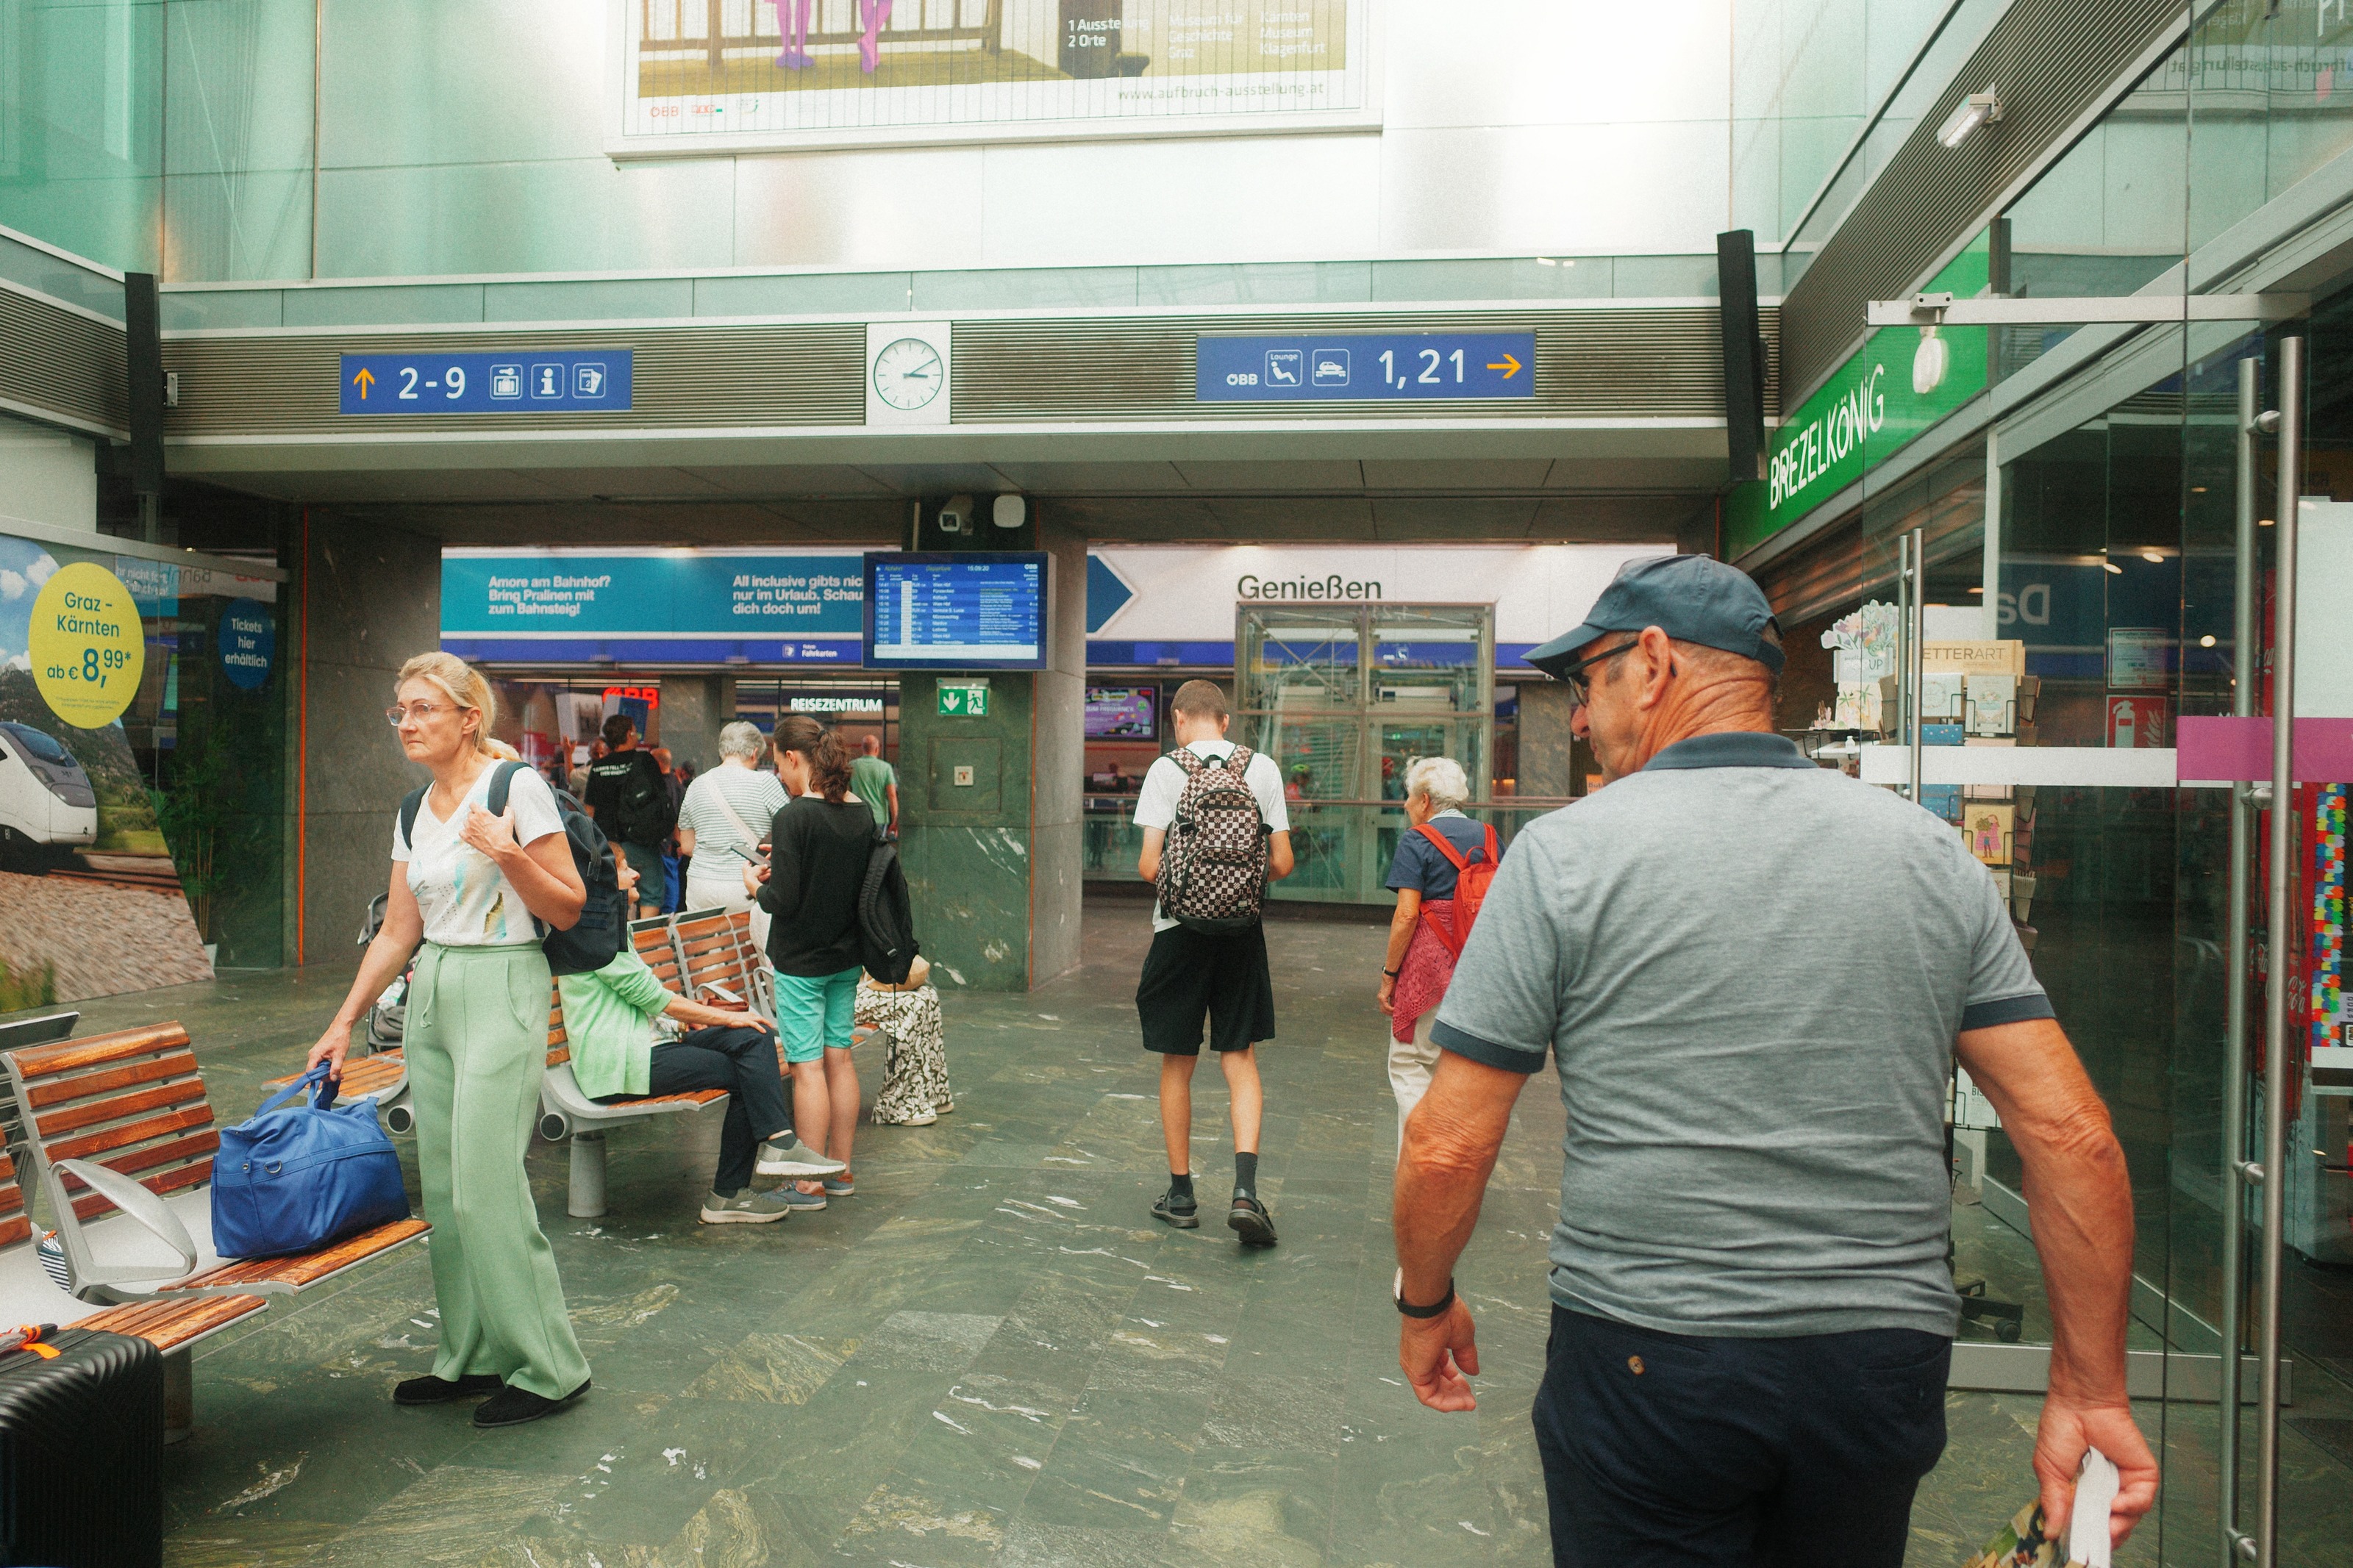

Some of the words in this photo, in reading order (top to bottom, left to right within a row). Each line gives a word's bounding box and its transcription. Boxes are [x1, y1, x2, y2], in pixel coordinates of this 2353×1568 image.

[1068, 20, 1075, 31] 1
[1169, 13, 1221, 26] Museum
[1168, 29, 1232, 43] Geschichte
[1260, 26, 1313, 39] Museum
[1068, 36, 1076, 48] 2
[1079, 35, 1107, 47] Orte
[1168, 47, 1195, 59] Graz
[1260, 41, 1326, 57] Klagenfurt
[1119, 82, 1324, 100] www.aufbruch-ausstellung.at
[1270, 352, 1299, 362] Lounge
[1226, 373, 1258, 385] ÖBB
[488, 576, 528, 587] Amore
[531, 578, 551, 587] am
[553, 575, 611, 587] Bahnhof?
[732, 575, 750, 587] All
[751, 575, 806, 587] inclusive
[808, 575, 840, 590] gibts
[843, 575, 863, 587] nic
[1238, 574, 1382, 600] Genießen
[488, 590, 519, 604] Bring
[523, 589, 572, 601] Pralinen
[574, 589, 595, 601] mit
[732, 590, 754, 601] nur
[757, 588, 773, 601] im
[775, 589, 821, 601] Urlaub.
[823, 589, 863, 601] Schau
[64, 592, 101, 612] Graz
[732, 602, 760, 615] dich
[762, 602, 794, 615] doch
[796, 602, 821, 615] um!
[488, 605, 514, 615] zum
[516, 602, 581, 617] Bahnsteig!
[57, 615, 120, 638] Kärnten
[231, 617, 263, 634] Tickets
[237, 636, 256, 650] hier
[224, 653, 268, 668] erhältlich
[801, 649, 838, 658] Fahrkarten
[1923, 648, 2006, 660] ETTERART
[46, 665, 65, 679] ab
[68, 667, 78, 680] €
[790, 698, 882, 712] REISEZENTRUM
